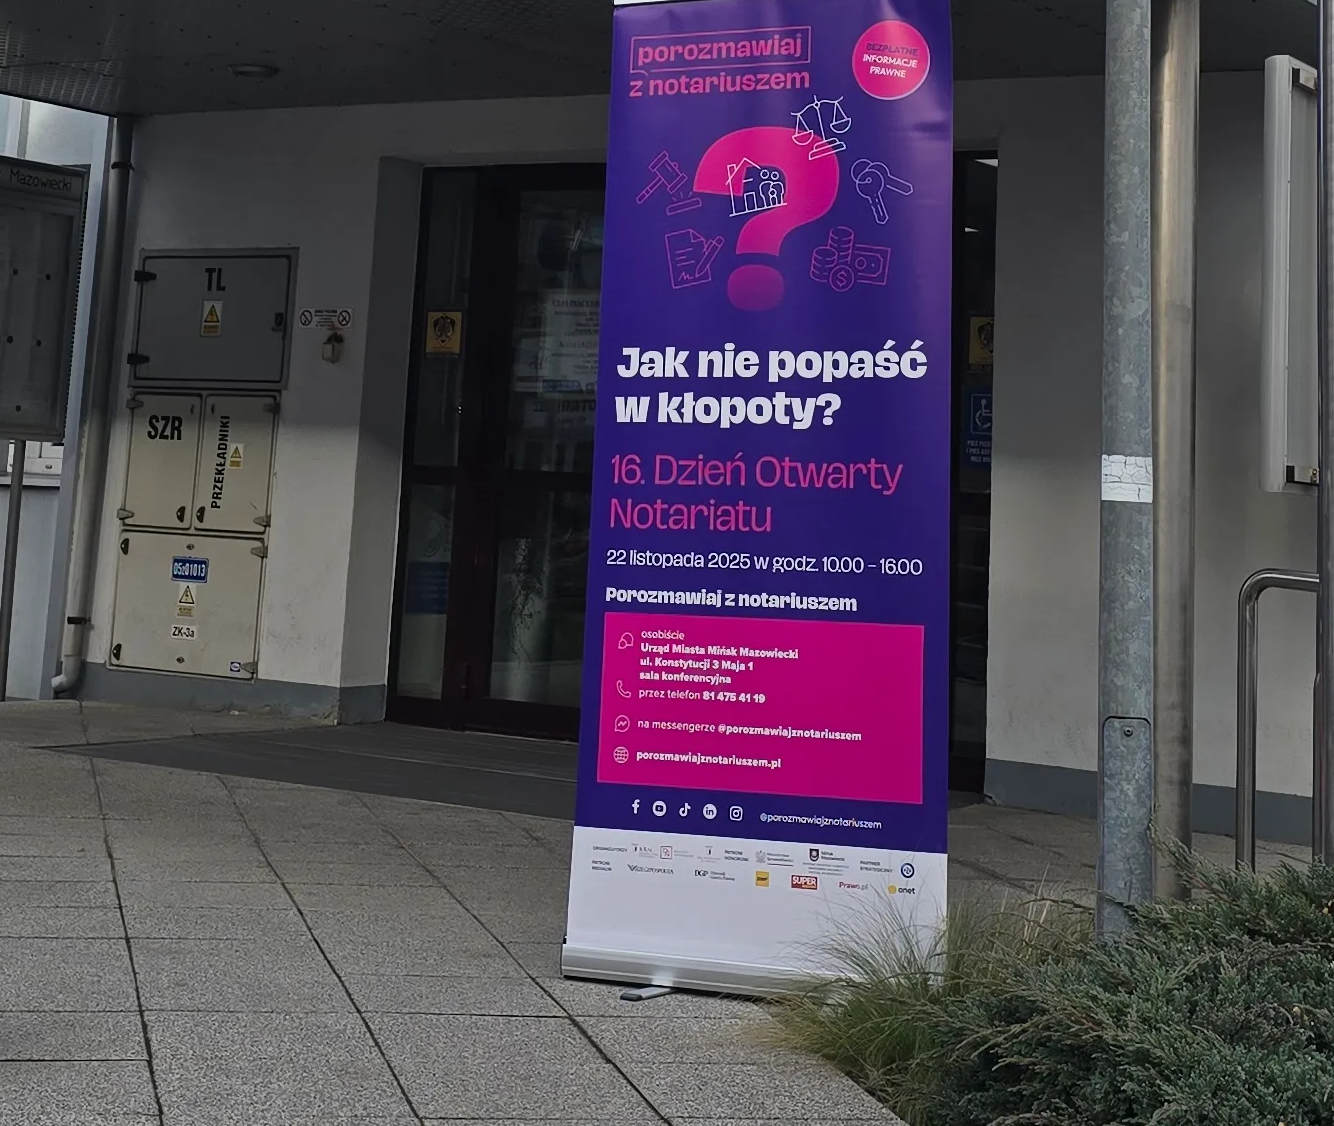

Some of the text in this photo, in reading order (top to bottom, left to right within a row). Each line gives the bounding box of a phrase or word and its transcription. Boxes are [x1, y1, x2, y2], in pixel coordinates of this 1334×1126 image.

[637, 32, 804, 67] porozmawiaj
[862, 53, 918, 68] INFORMACJE
[869, 65, 907, 79] PRAWNE
[629, 71, 810, 98] z notariuszem
[9, 166, 73, 193] Mazowiecki
[204, 267, 226, 292] TL
[616, 345, 690, 379] Jak
[697, 342, 760, 378] nie
[767, 339, 928, 384] popaść
[614, 395, 650, 423] w
[656, 390, 842, 430] kłopoty?
[147, 414, 183, 441] SZR
[210, 415, 231, 509] PRZEKŁADNIKI
[611, 451, 904, 496] 16. Dzień Otwarty
[609, 497, 773, 533] Notariatu
[606, 549, 627, 567] 22
[629, 549, 705, 570] listopada
[708, 552, 751, 570] 2025
[754, 557, 769, 571] w
[772, 554, 819, 573] godz.
[605, 586, 858, 612] Porozmawiaj z notariuszem
[172, 626, 195, 638] ZK-3a
[641, 629, 685, 641] osobiście
[640, 643, 799, 659] Urząd Miasta Mińsk Mazowiecki
[640, 657, 652, 667] ul.
[655, 657, 711, 671] Konstytucji
[712, 660, 720, 669] 3
[721, 660, 746, 673] Maja
[640, 671, 732, 686] sala konferencyjna
[638, 688, 766, 704] przez telefon 81 475 41 19
[637, 719, 863, 742] na messengerze @porozmawiajznotariuszem
[636, 749, 782, 769] porozmawiajznotariuszem.pl
[759, 811, 883, 831] @porozmawiajznotariuszem
[694, 869, 709, 877] DGP
[792, 876, 817, 886] SUPER
[839, 881, 869, 892] Prawo.pl
[897, 886, 916, 895] onet
